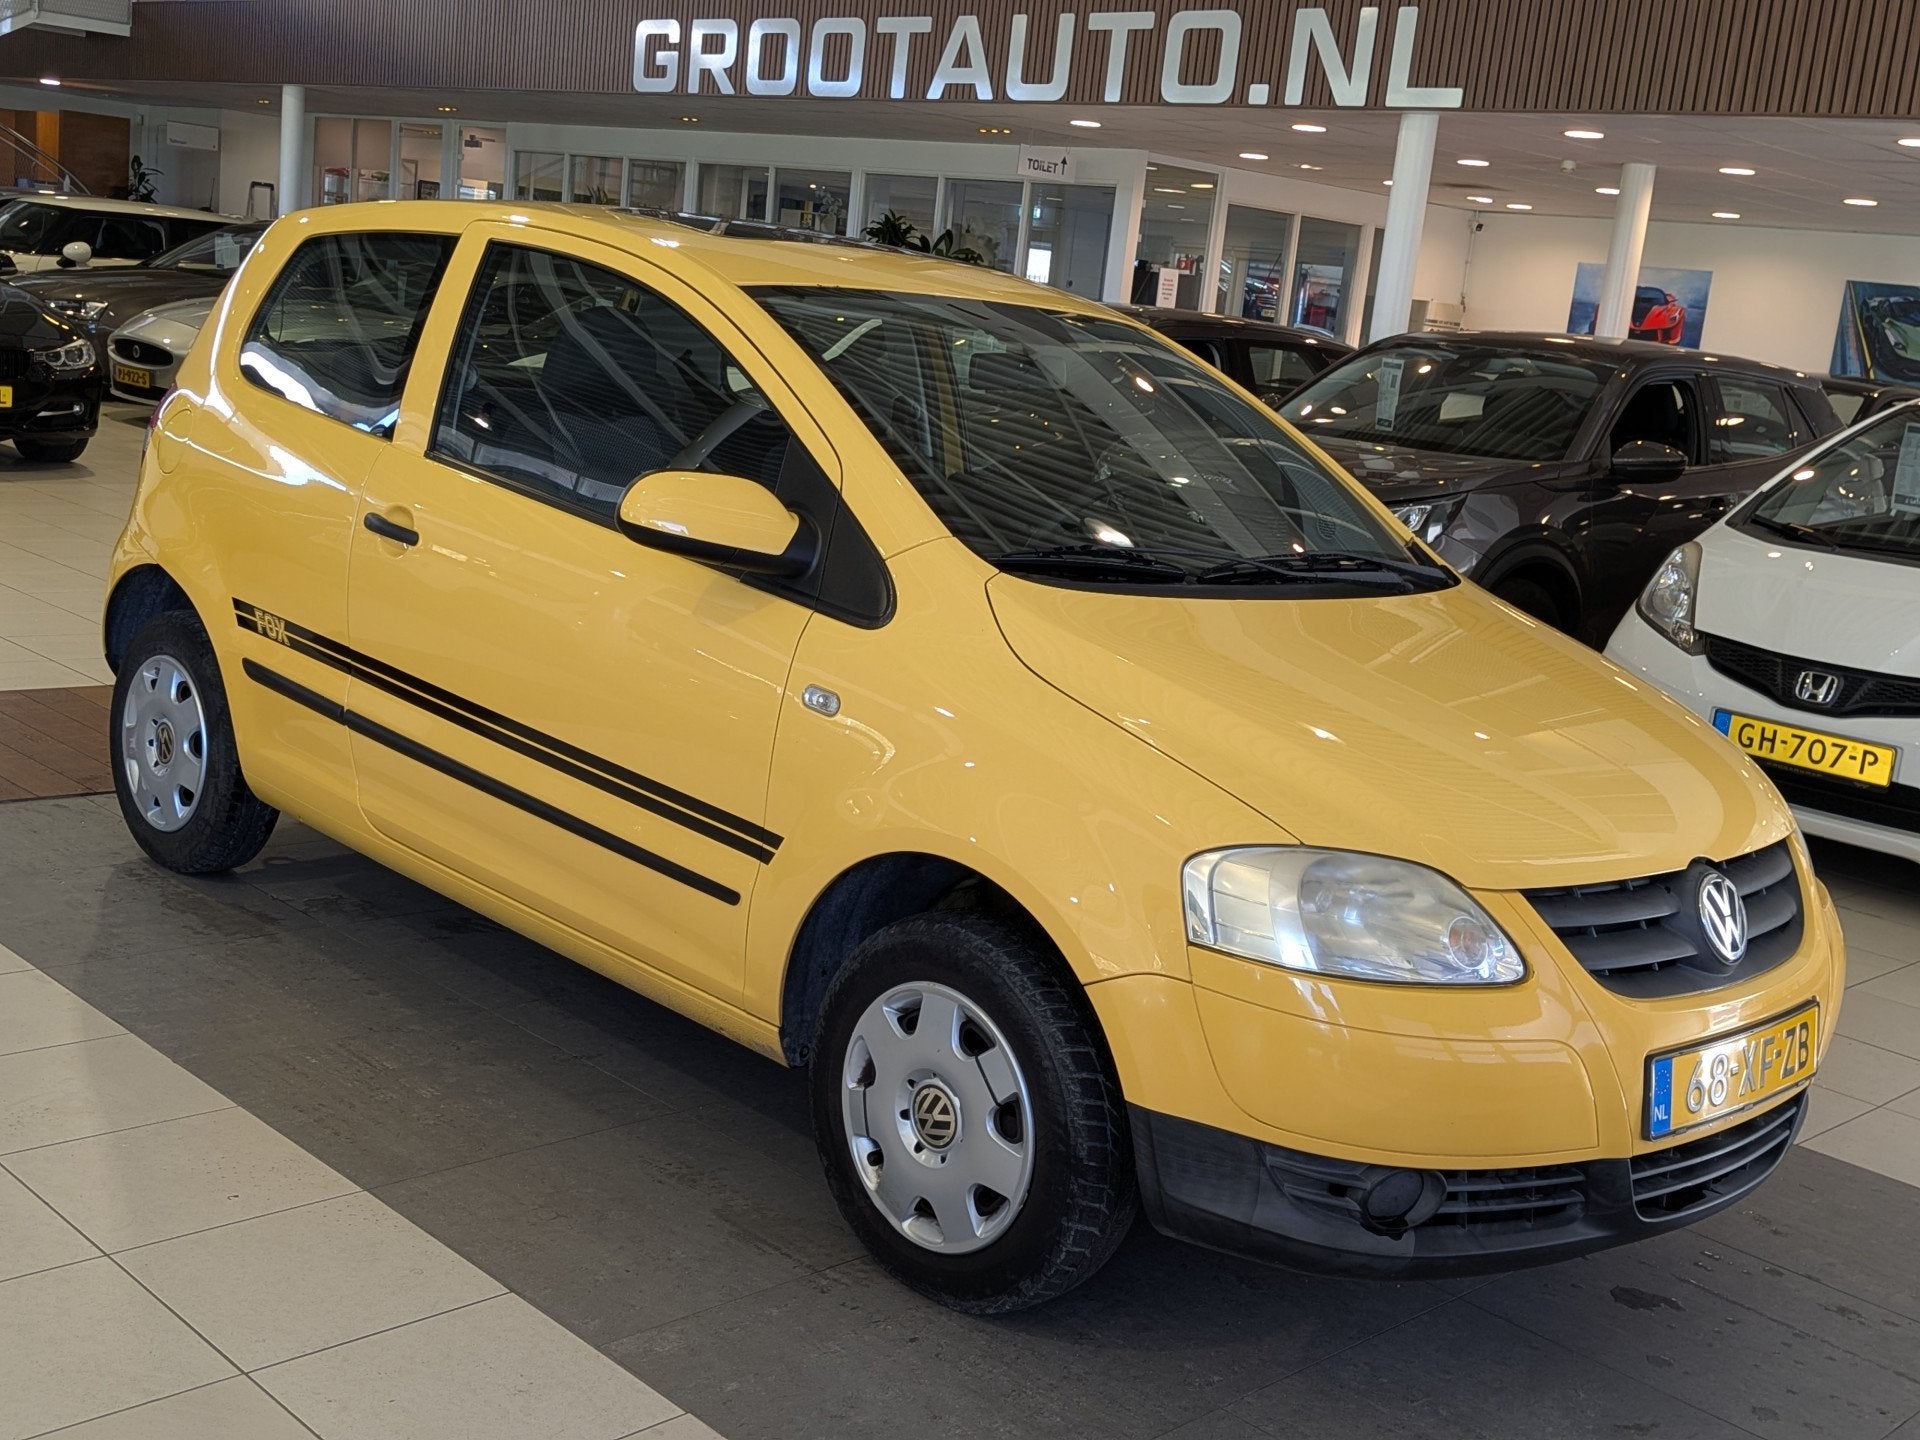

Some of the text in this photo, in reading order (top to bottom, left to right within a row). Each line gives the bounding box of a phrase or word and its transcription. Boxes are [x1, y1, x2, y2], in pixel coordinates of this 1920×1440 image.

[633, 6, 1463, 108] GROOTAUTO.NL
[1027, 158, 1059, 174] TOILET
[253, 607, 291, 646] FOX
[1737, 722, 1879, 775] GH-707-P
[1687, 1021, 1809, 1114] 68-XF-ZB
[1653, 1105, 1668, 1123] NL
